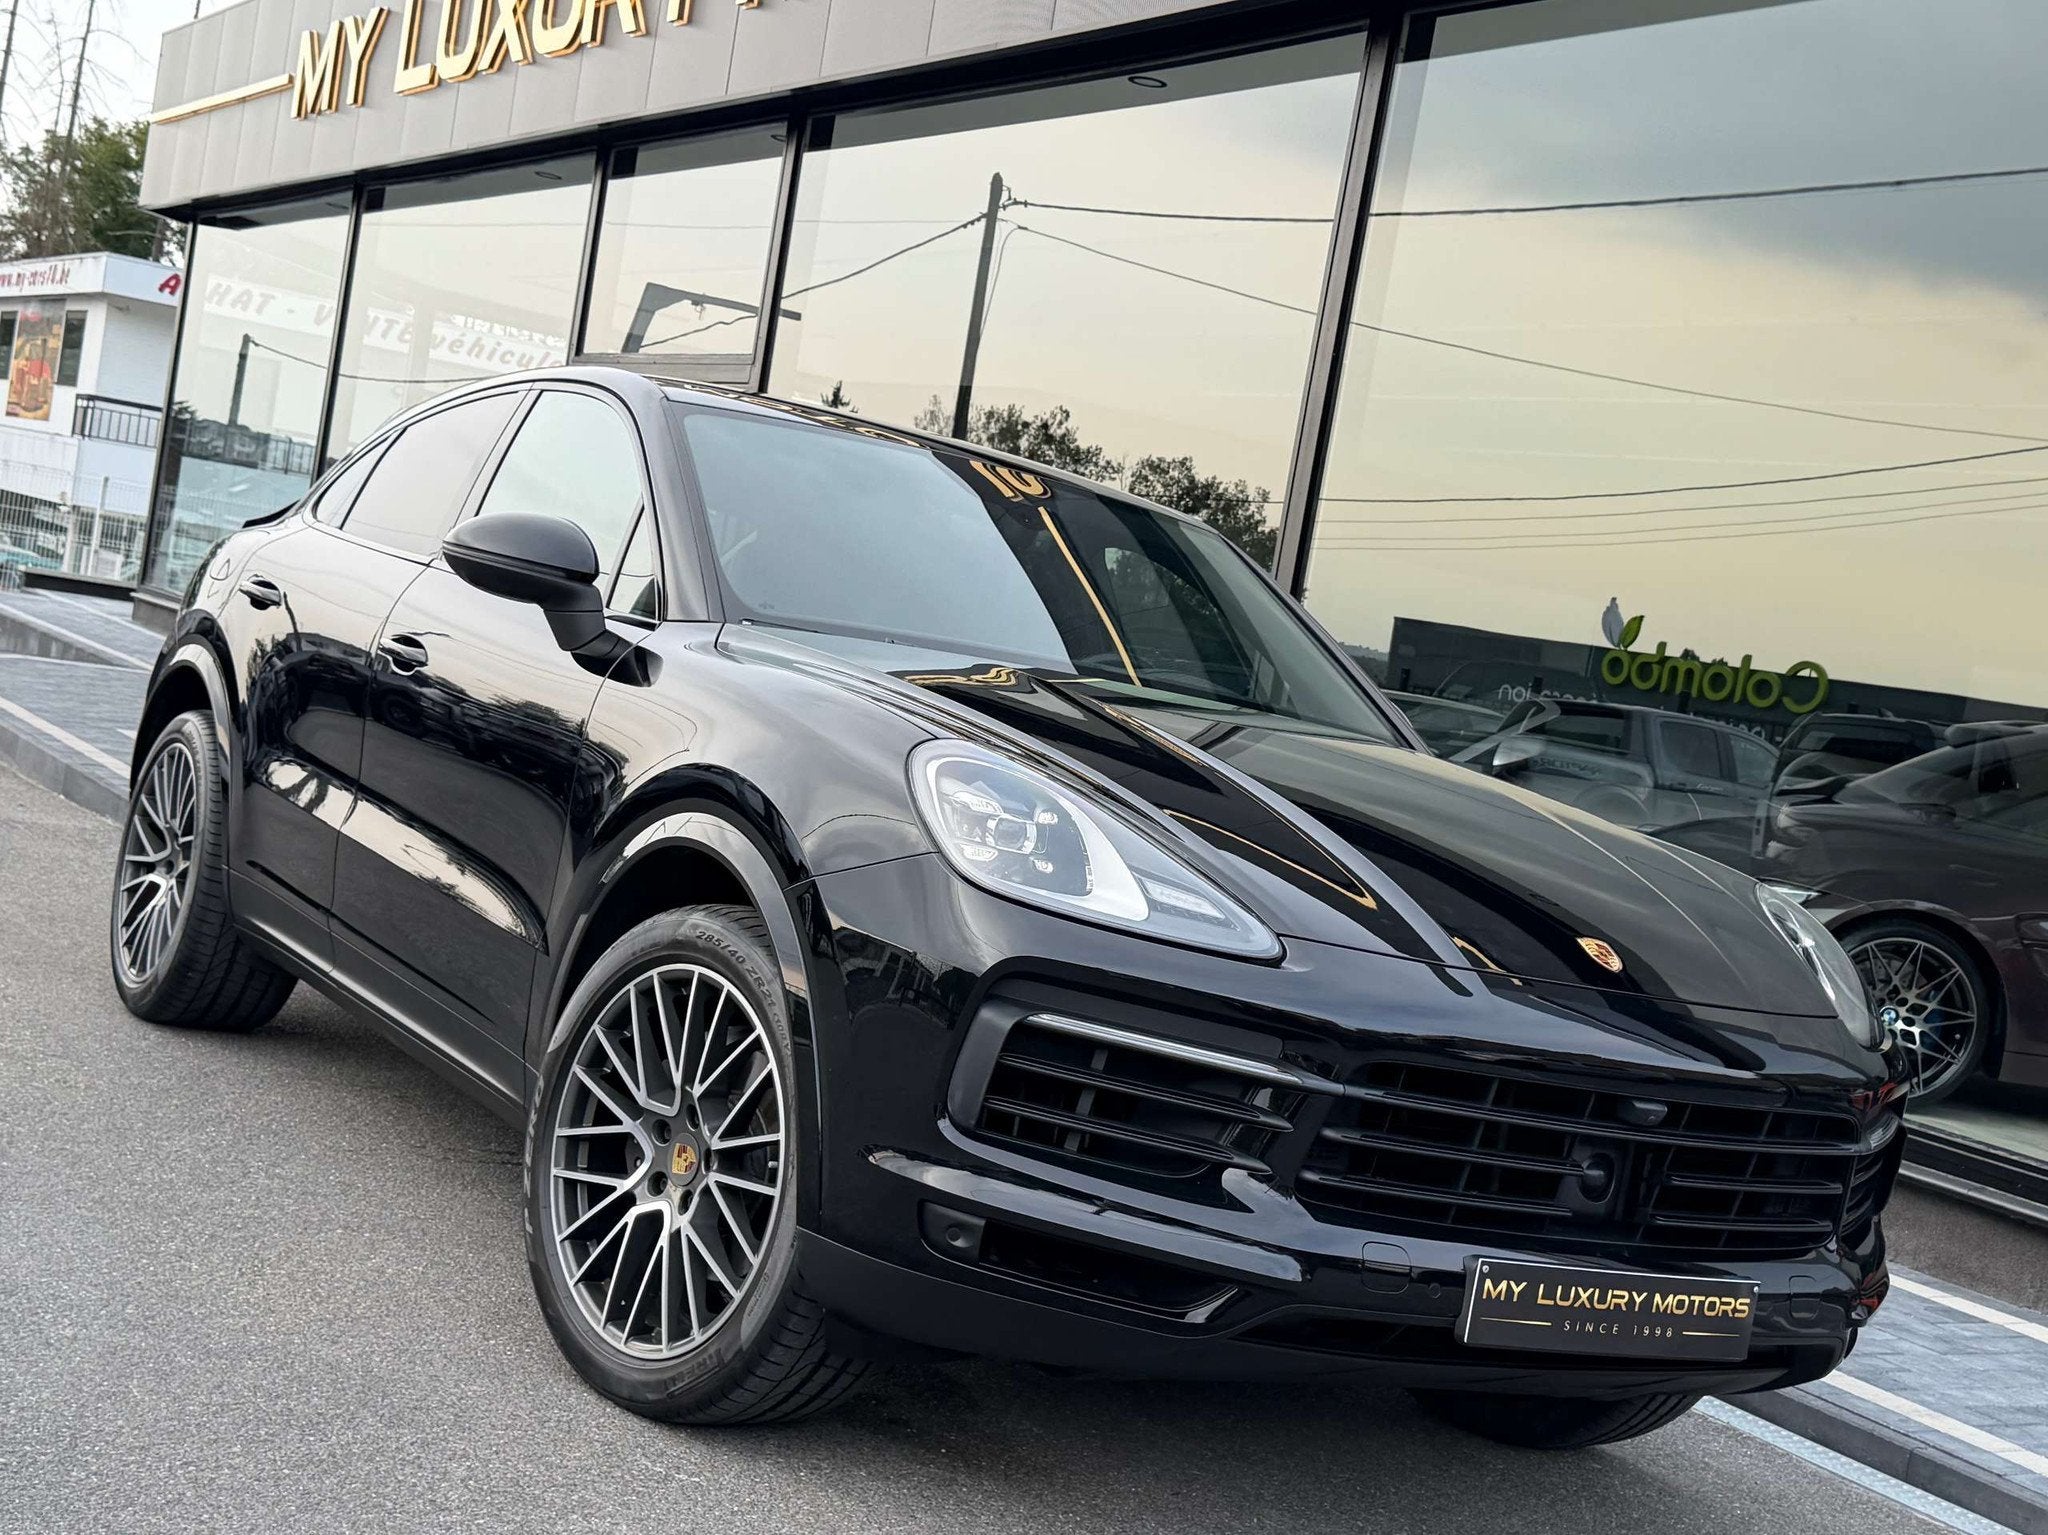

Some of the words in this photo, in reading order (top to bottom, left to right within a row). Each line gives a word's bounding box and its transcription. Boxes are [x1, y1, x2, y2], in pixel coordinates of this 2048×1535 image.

[290, 6, 390, 120] MY
[695, 930, 746, 965] 285/40
[1482, 1278, 1528, 1303] MY
[1537, 1283, 1648, 1312] LUXURY
[1651, 1292, 1751, 1319] MOTORS
[1564, 1320, 1619, 1335] SINCE
[1632, 1324, 1673, 1338] 1998
